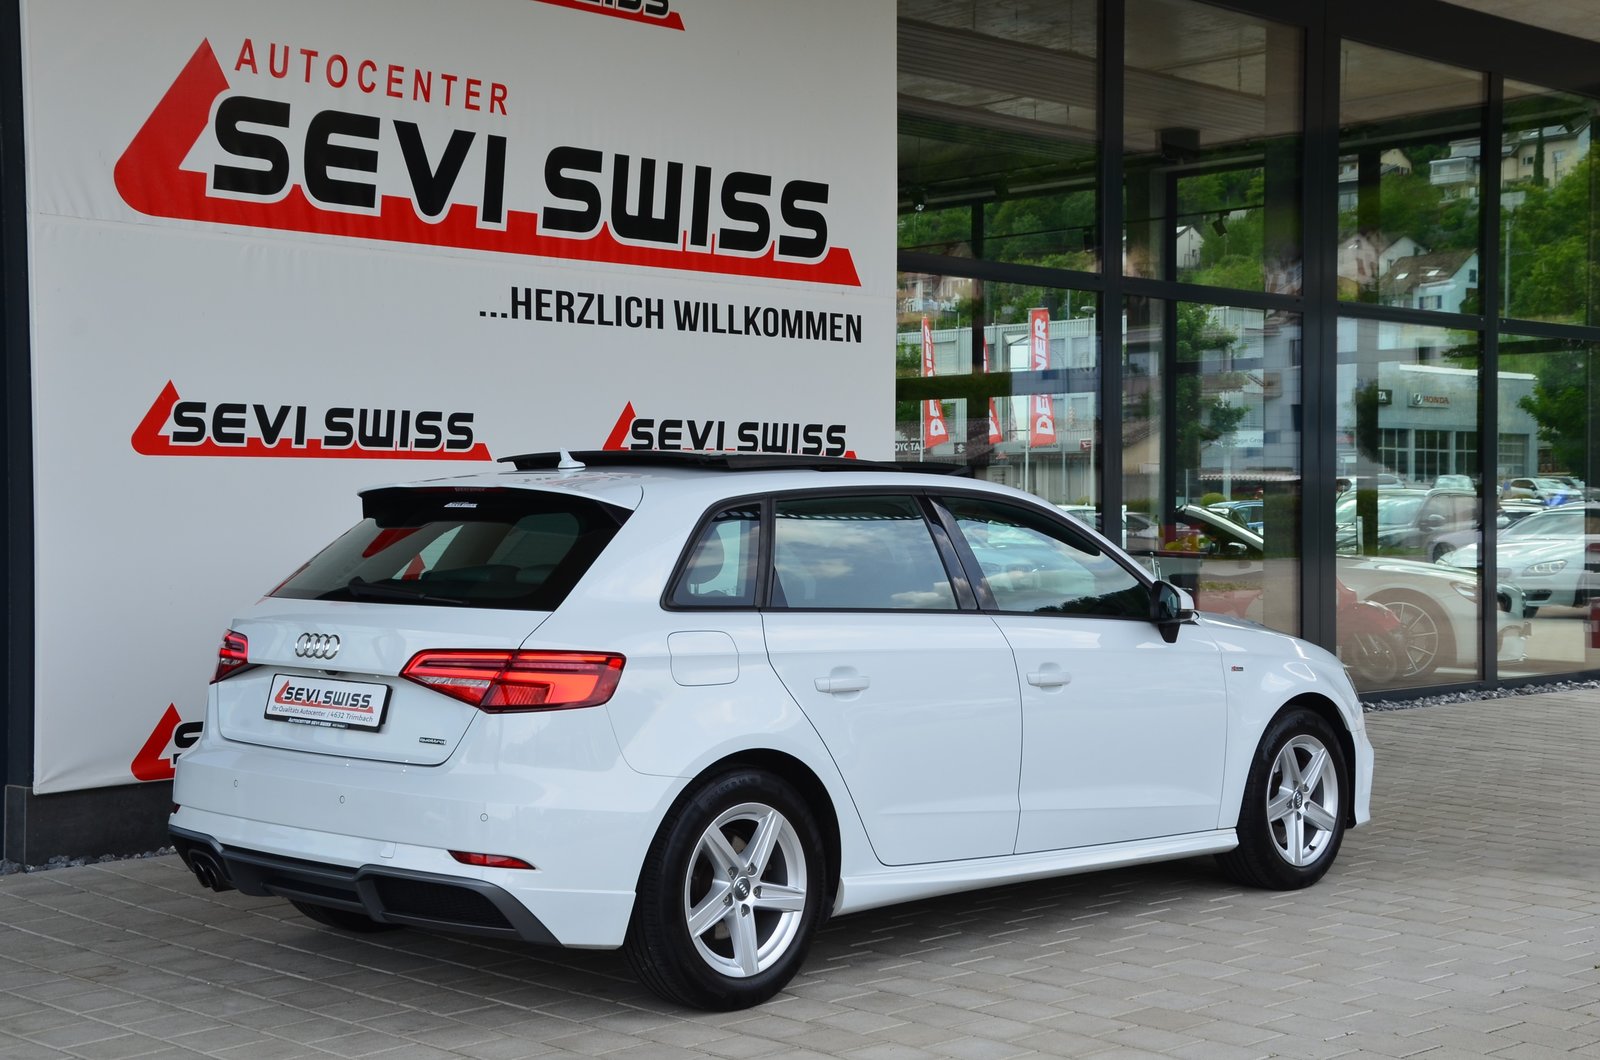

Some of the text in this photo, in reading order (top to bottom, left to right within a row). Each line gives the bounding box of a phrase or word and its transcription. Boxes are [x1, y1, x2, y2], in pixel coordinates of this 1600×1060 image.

[235, 39, 508, 115] AUTOCENTER
[213, 96, 828, 258] SEVI SWISS
[674, 300, 861, 342] WILLKOMMEN
[1423, 395, 1450, 405] HONDA
[173, 402, 473, 449] SEVI SWISS
[631, 419, 846, 456] SEVI SWISS
[284, 686, 372, 709] SEVI SWISS
[300, 709, 326, 717] Autocenter
[346, 713, 374, 723] Trimbach
